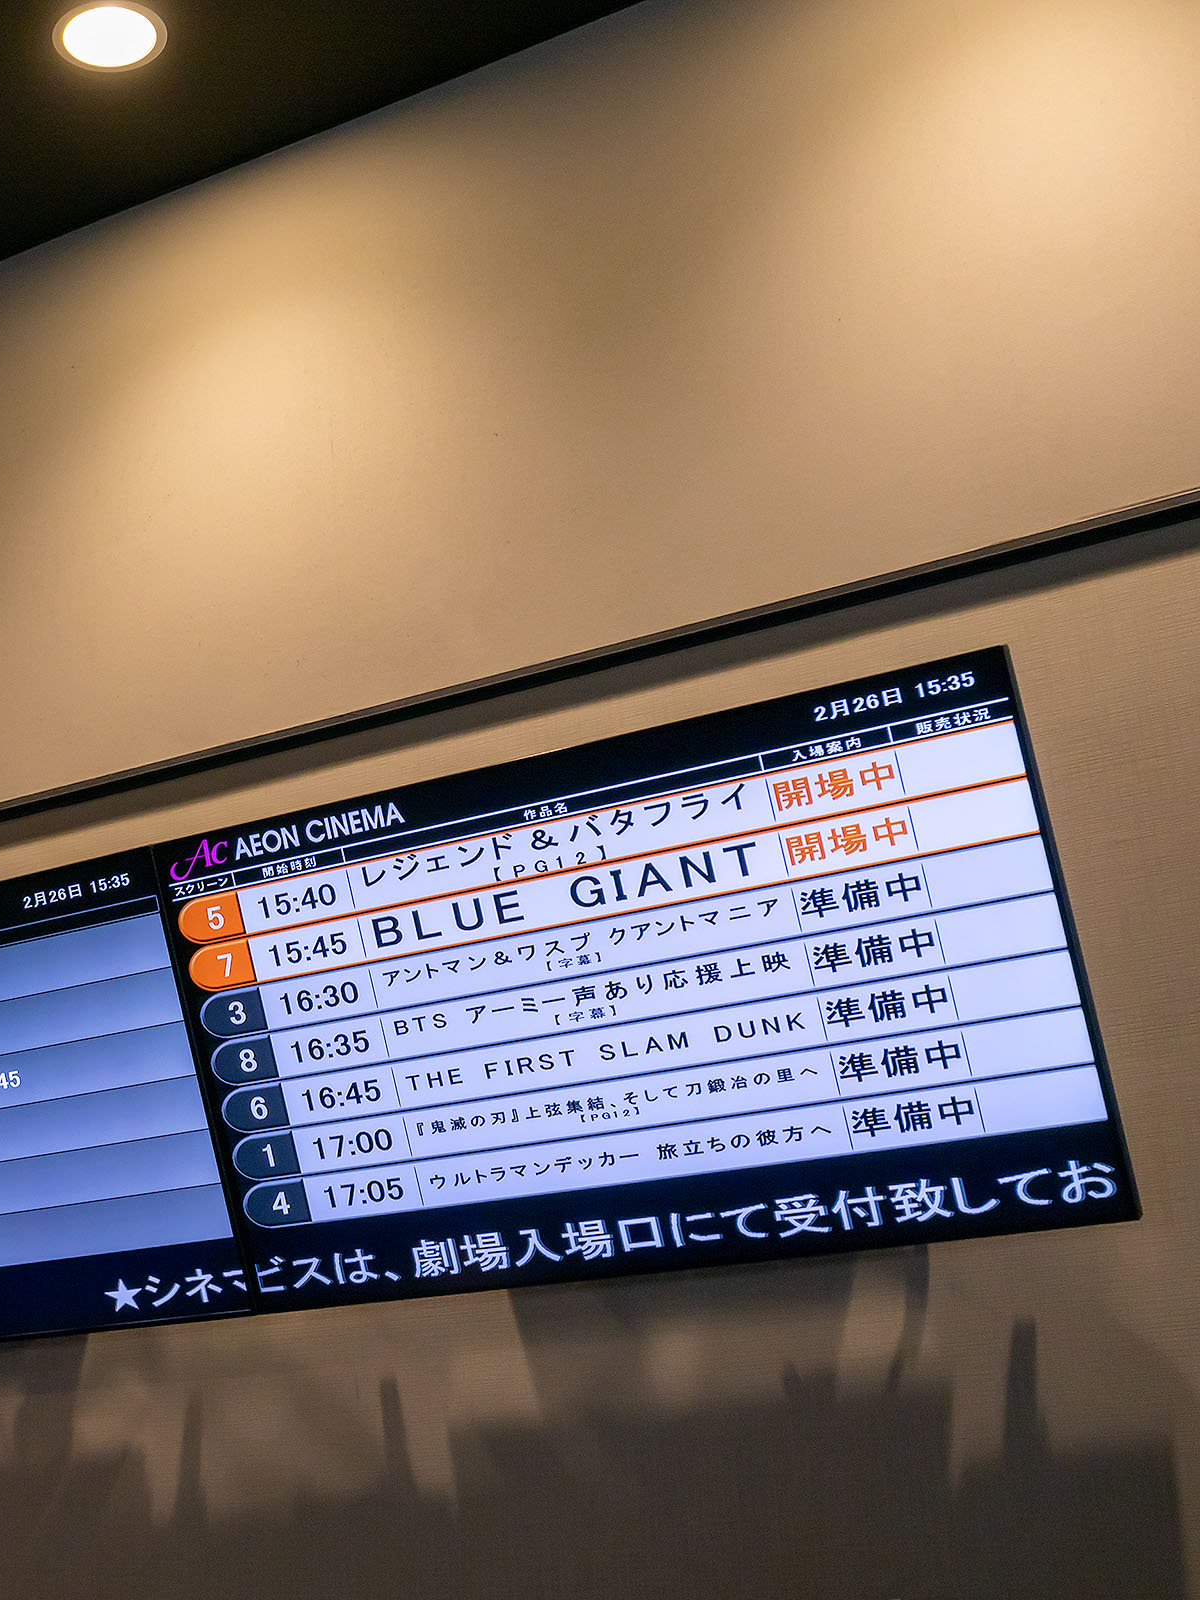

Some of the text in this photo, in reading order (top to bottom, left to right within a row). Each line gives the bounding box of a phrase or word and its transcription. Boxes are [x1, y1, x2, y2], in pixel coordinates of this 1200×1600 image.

[813, 671, 976, 723] 2月26日 15:35
[916, 707, 991, 735] 販売状況
[791, 737, 863, 762] 入場案内
[772, 760, 896, 812] 開場中
[523, 802, 569, 822] 作品名
[234, 824, 300, 861] AEON
[305, 802, 405, 843] CINEMA
[785, 816, 909, 866] 開場中
[262, 855, 317, 878] 開始時刻
[23, 873, 130, 909] 2月26日 15:35
[174, 877, 230, 897] スクリーン
[256, 883, 337, 919] 15:40
[371, 841, 757, 949] BLUE GIANT
[799, 872, 922, 919] 準備中
[206, 905, 225, 931] 5
[608, 898, 778, 946] クアントマニア
[216, 953, 233, 978] 7
[268, 931, 348, 968] 15:45
[812, 927, 936, 974] 準備中
[228, 1000, 247, 1026] 3
[279, 981, 359, 1016] 16:30
[825, 983, 949, 1029] 準備中
[392, 1012, 448, 1038] BTS
[239, 1048, 259, 1073] 8
[290, 1030, 371, 1064] 16:35
[405, 1012, 807, 1091] THE FIRST SLAM DUNK
[838, 1040, 962, 1083] 準備中
[249, 1095, 270, 1121] 6
[301, 1079, 382, 1112] 16:45
[850, 1095, 975, 1138] 準備中
[261, 1143, 277, 1168] 1
[312, 1128, 393, 1161] 17:00
[429, 1124, 832, 1190] ウルトラマンデッカー 旅立ちの彼方へ
[272, 1192, 290, 1215] 4
[323, 1178, 404, 1209] 17:05
